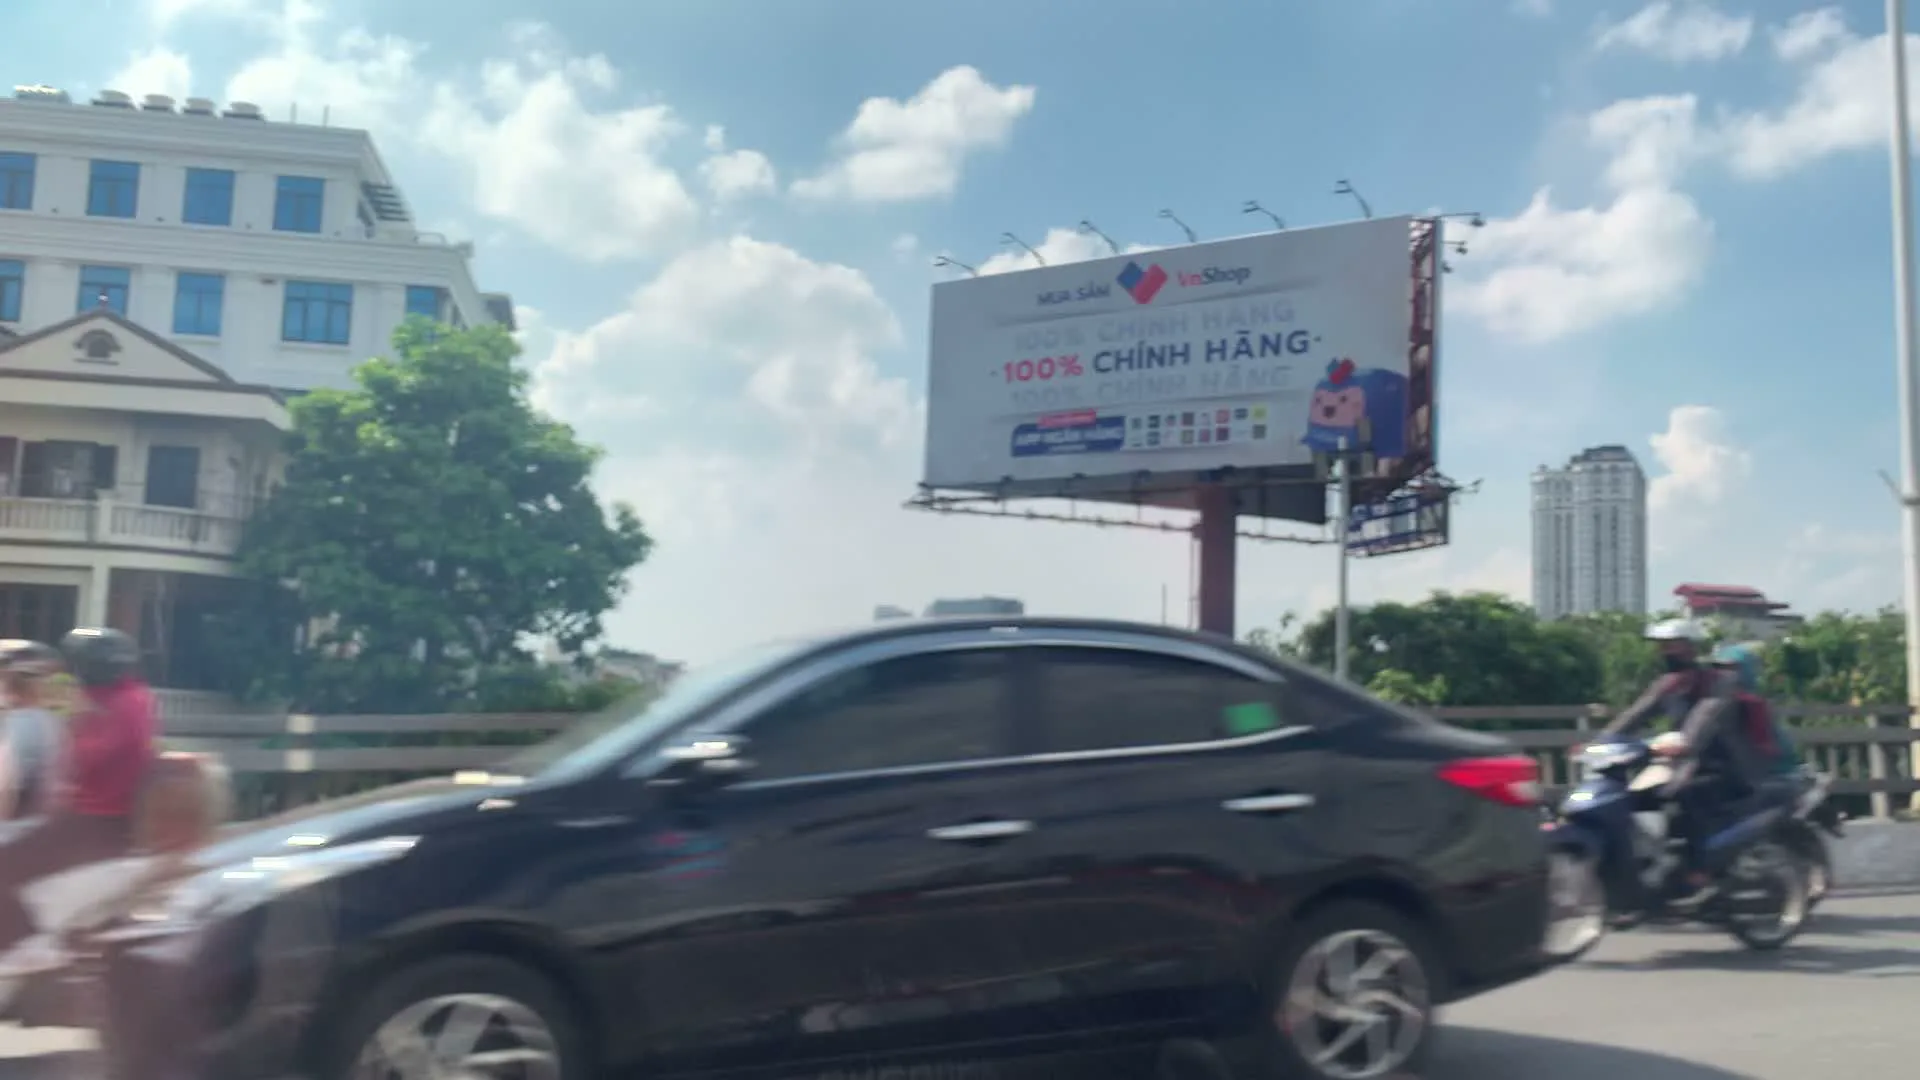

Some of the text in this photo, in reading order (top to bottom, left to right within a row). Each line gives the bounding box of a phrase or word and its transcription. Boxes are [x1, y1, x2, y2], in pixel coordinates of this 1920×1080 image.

[1178, 266, 1251, 288] VnShop
[1003, 353, 1084, 384] 100%
[1093, 341, 1190, 374] CHÍNH
